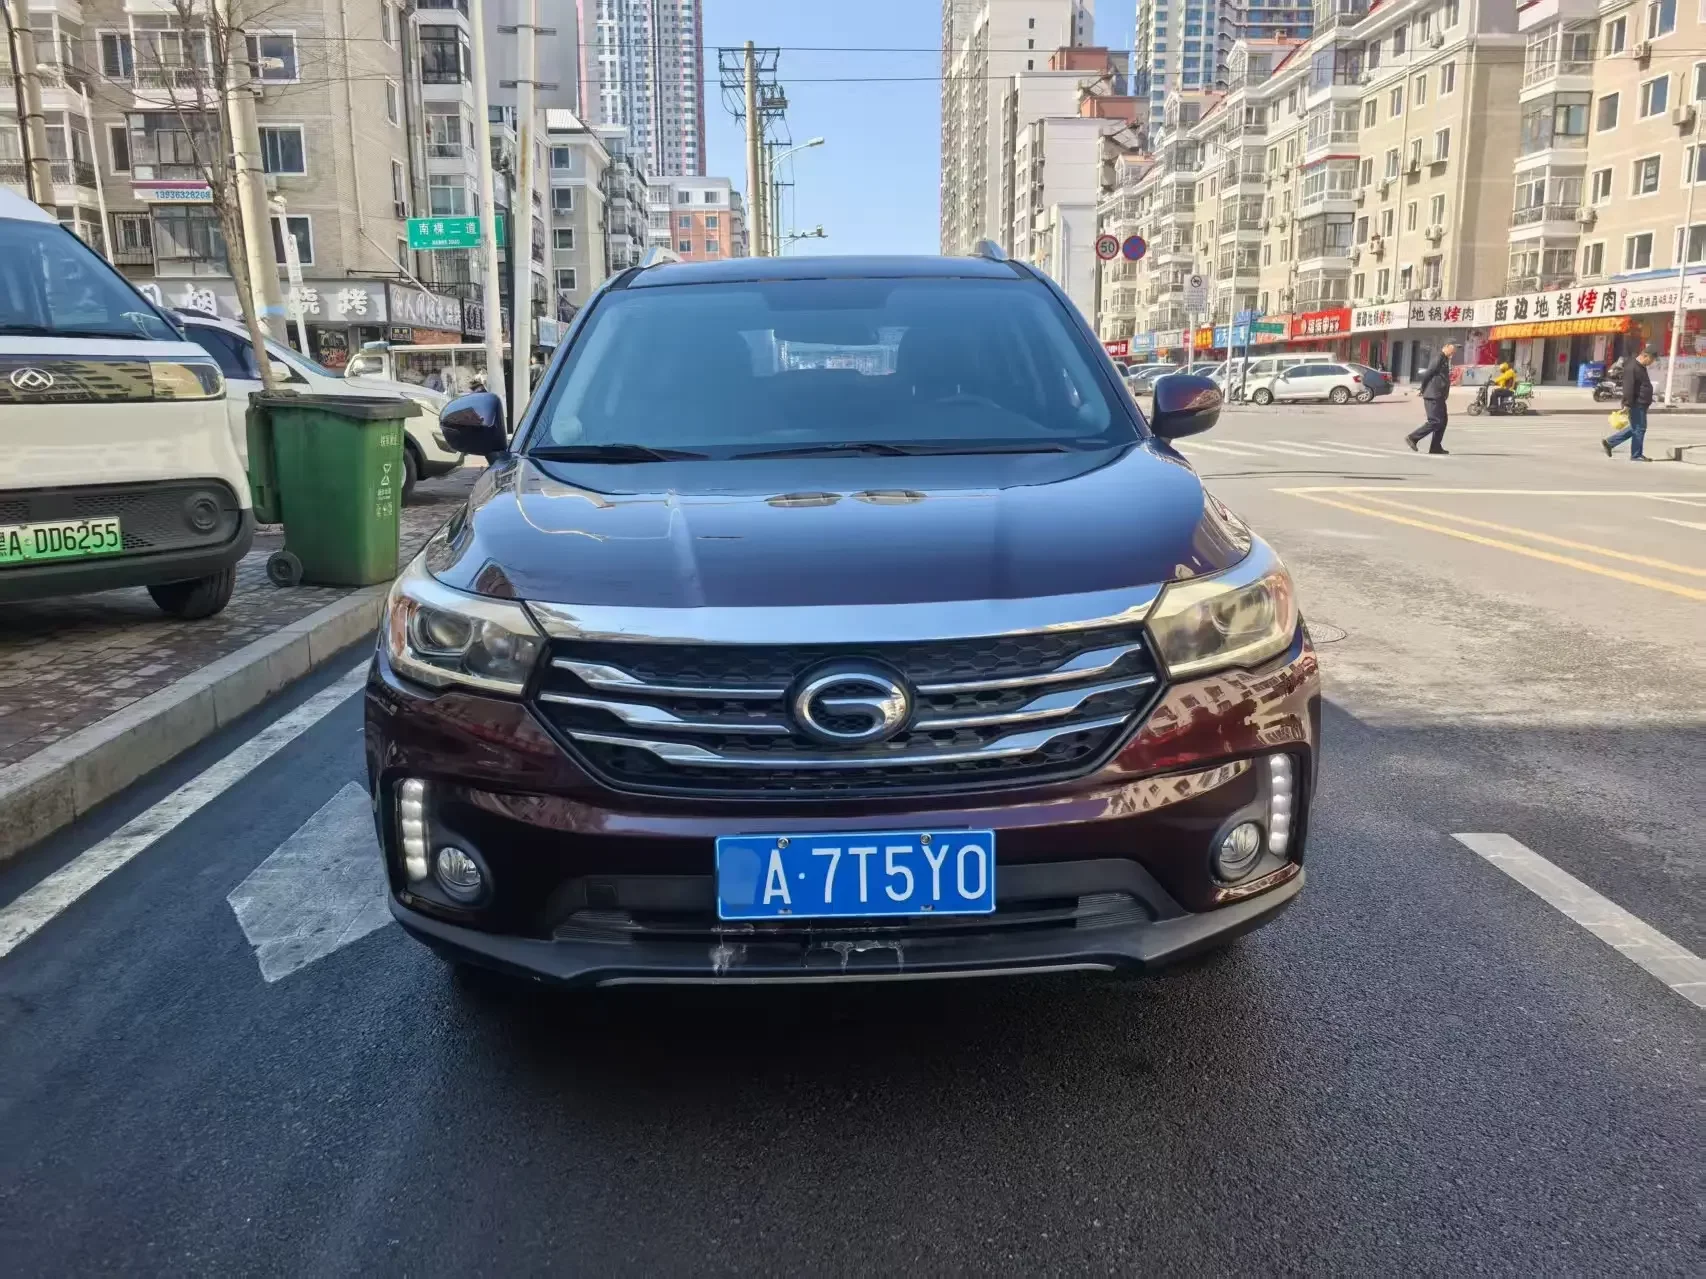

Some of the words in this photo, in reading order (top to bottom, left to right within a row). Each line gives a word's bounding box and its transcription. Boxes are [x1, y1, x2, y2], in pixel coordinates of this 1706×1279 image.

[1101, 241, 1116, 254] 50
[1410, 305, 1475, 322] 地锅烤肉
[1494, 288, 1617, 322] 街边地锅烤肉
